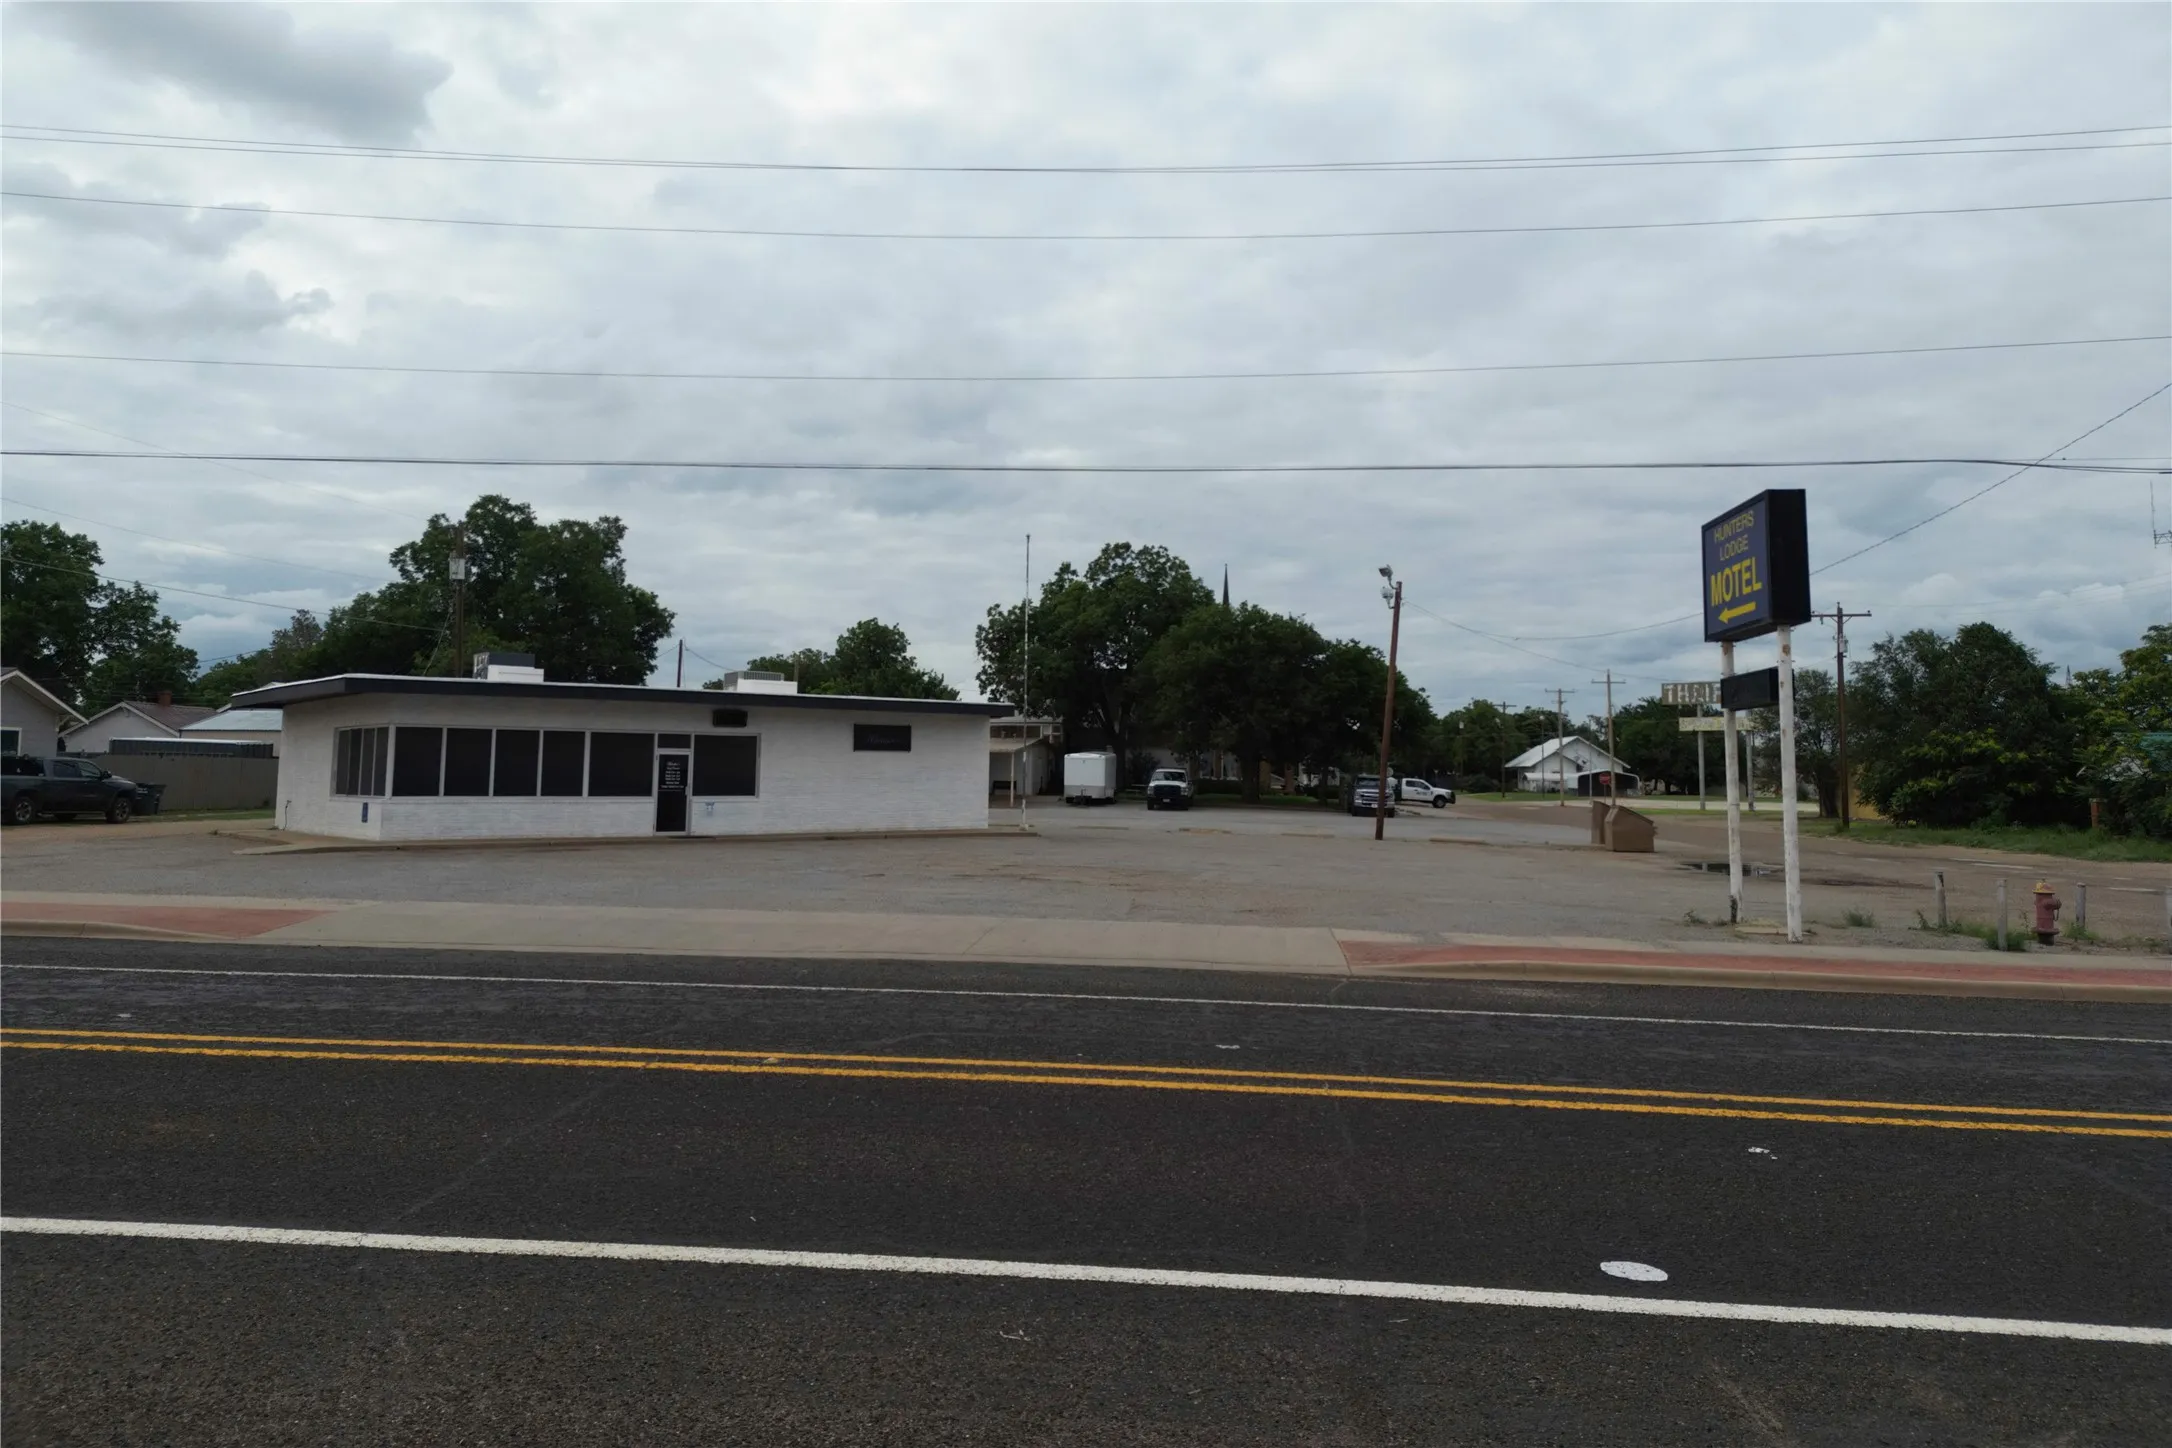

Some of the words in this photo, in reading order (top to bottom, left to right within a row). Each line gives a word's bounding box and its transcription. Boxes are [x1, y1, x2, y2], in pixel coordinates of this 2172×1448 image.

[1714, 510, 1755, 543] HUNTERS
[1719, 534, 1749, 561] LODGE
[1710, 556, 1763, 607] MOTEL
[1663, 683, 1721, 704] THRIF
